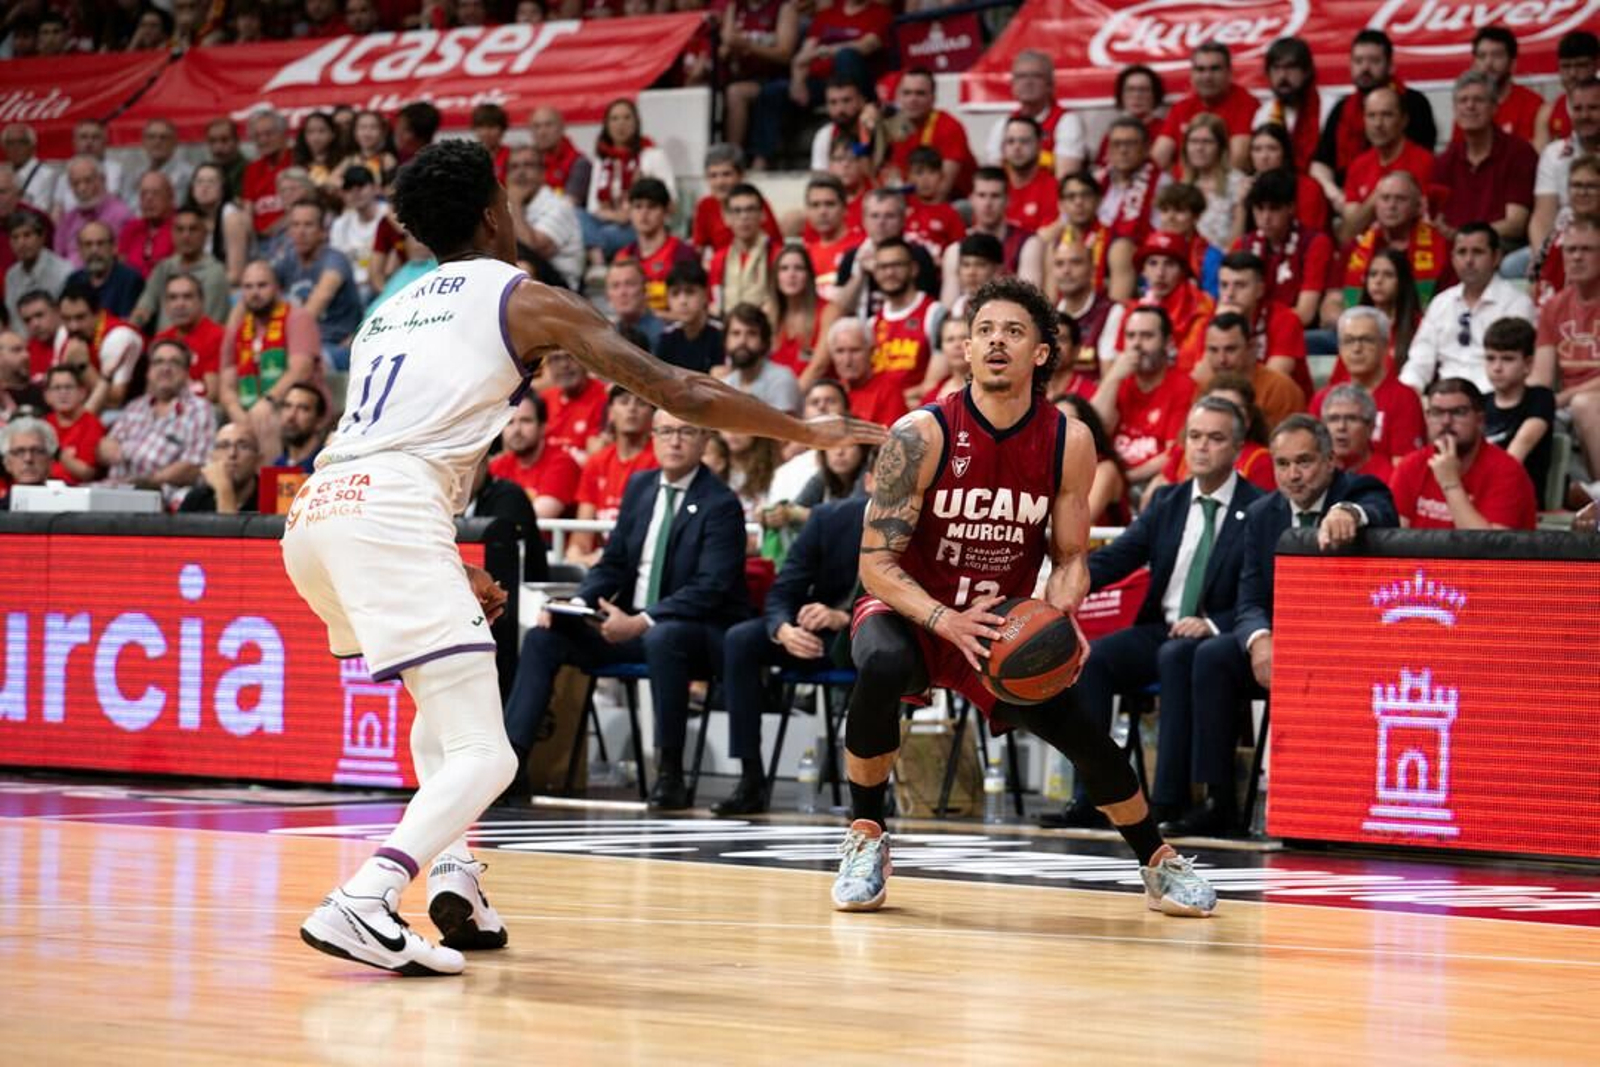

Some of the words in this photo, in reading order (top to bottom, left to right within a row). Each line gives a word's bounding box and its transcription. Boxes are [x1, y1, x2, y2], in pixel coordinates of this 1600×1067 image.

[1112, 16, 1272, 54] Juver
[1391, 0, 1577, 33] Juver
[330, 20, 583, 84] caser
[343, 352, 407, 435] 11
[334, 489, 367, 503] SOL
[933, 487, 1049, 525] UCAM
[946, 522, 1024, 545] MURCIA
